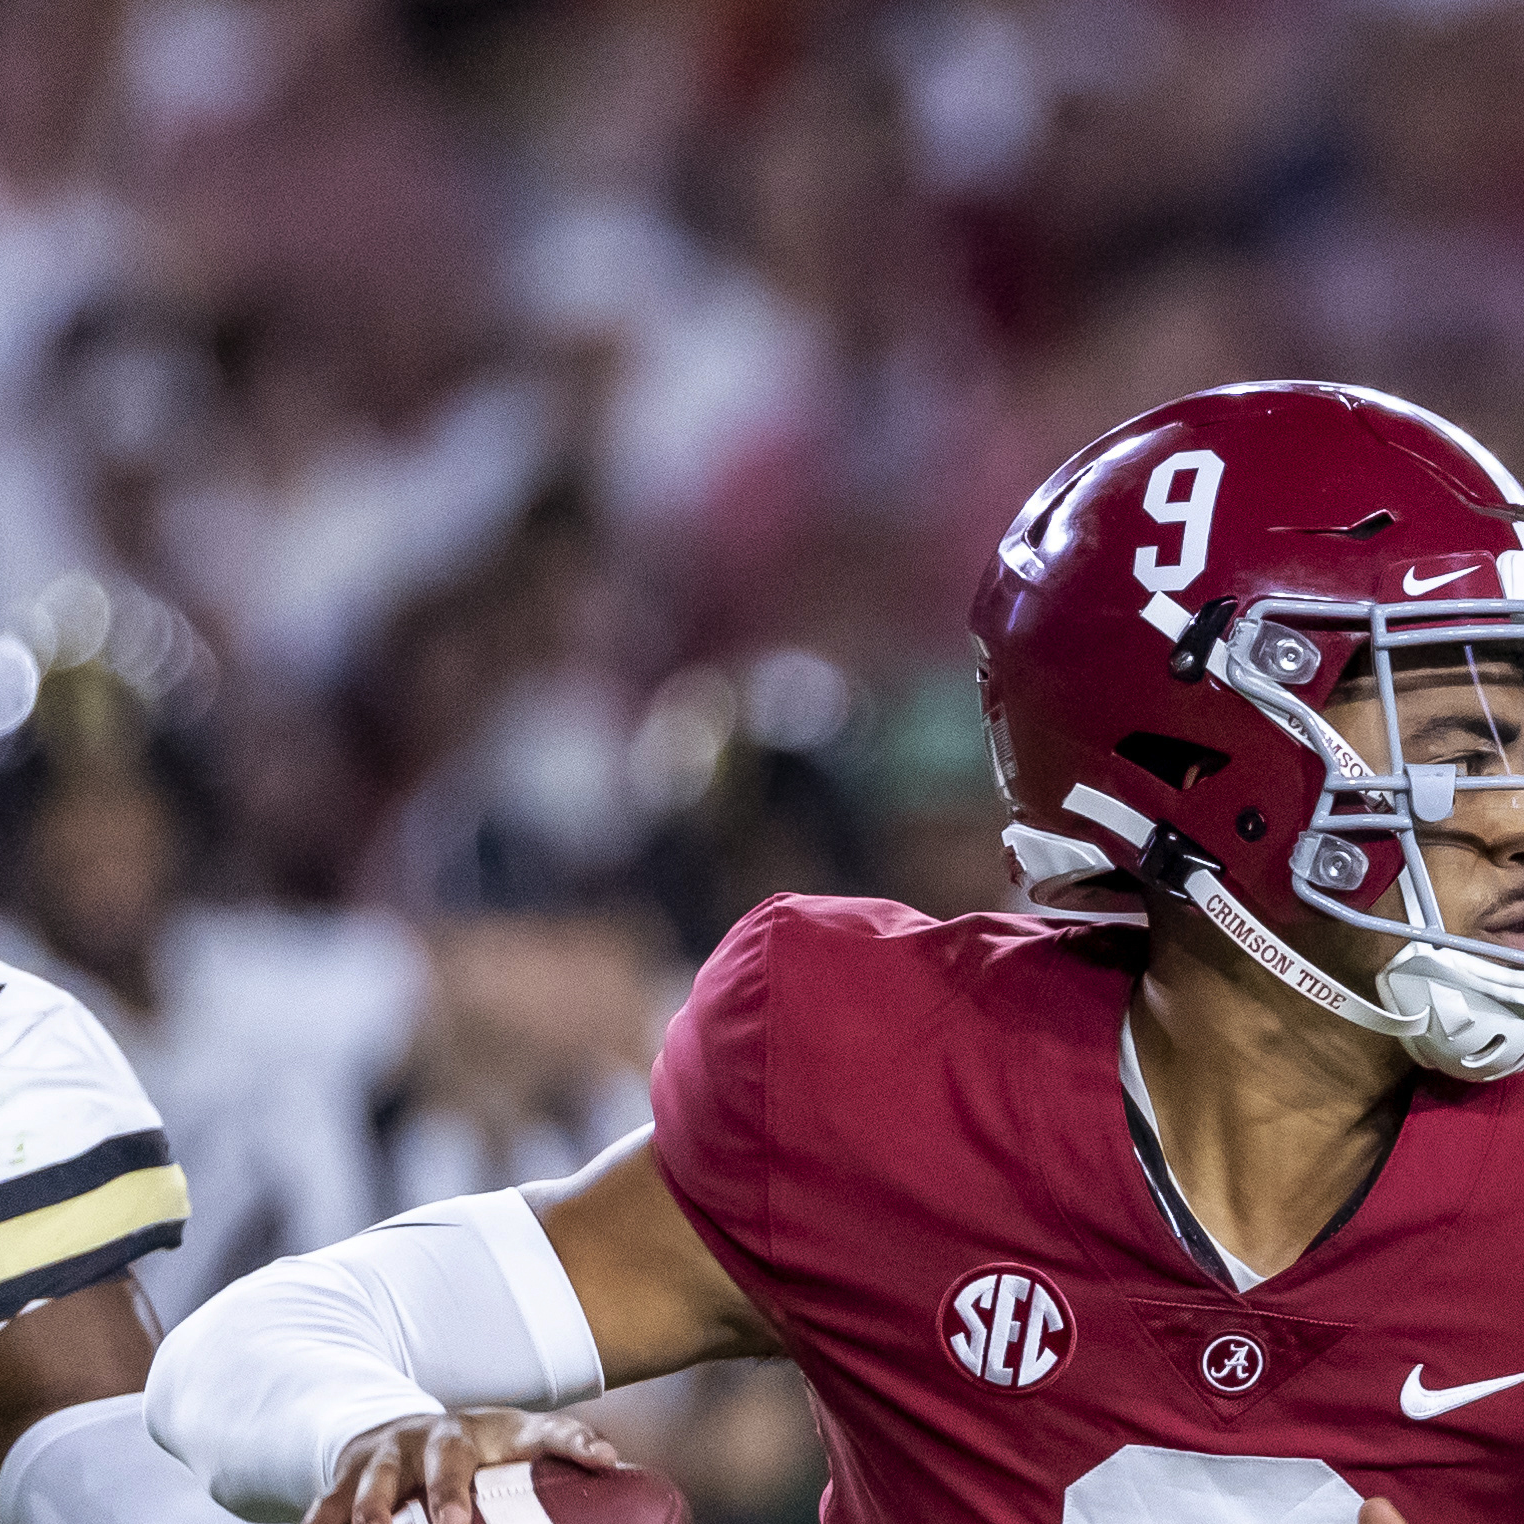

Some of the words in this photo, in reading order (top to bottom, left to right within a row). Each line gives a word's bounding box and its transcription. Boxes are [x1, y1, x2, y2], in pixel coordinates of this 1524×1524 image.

[1133, 449, 1225, 591] 9
[1206, 894, 1295, 976] CRIMSON
[1296, 968, 1348, 1010] TIDE
[949, 1274, 1064, 1387] SEC
[1210, 1343, 1250, 1379] A
